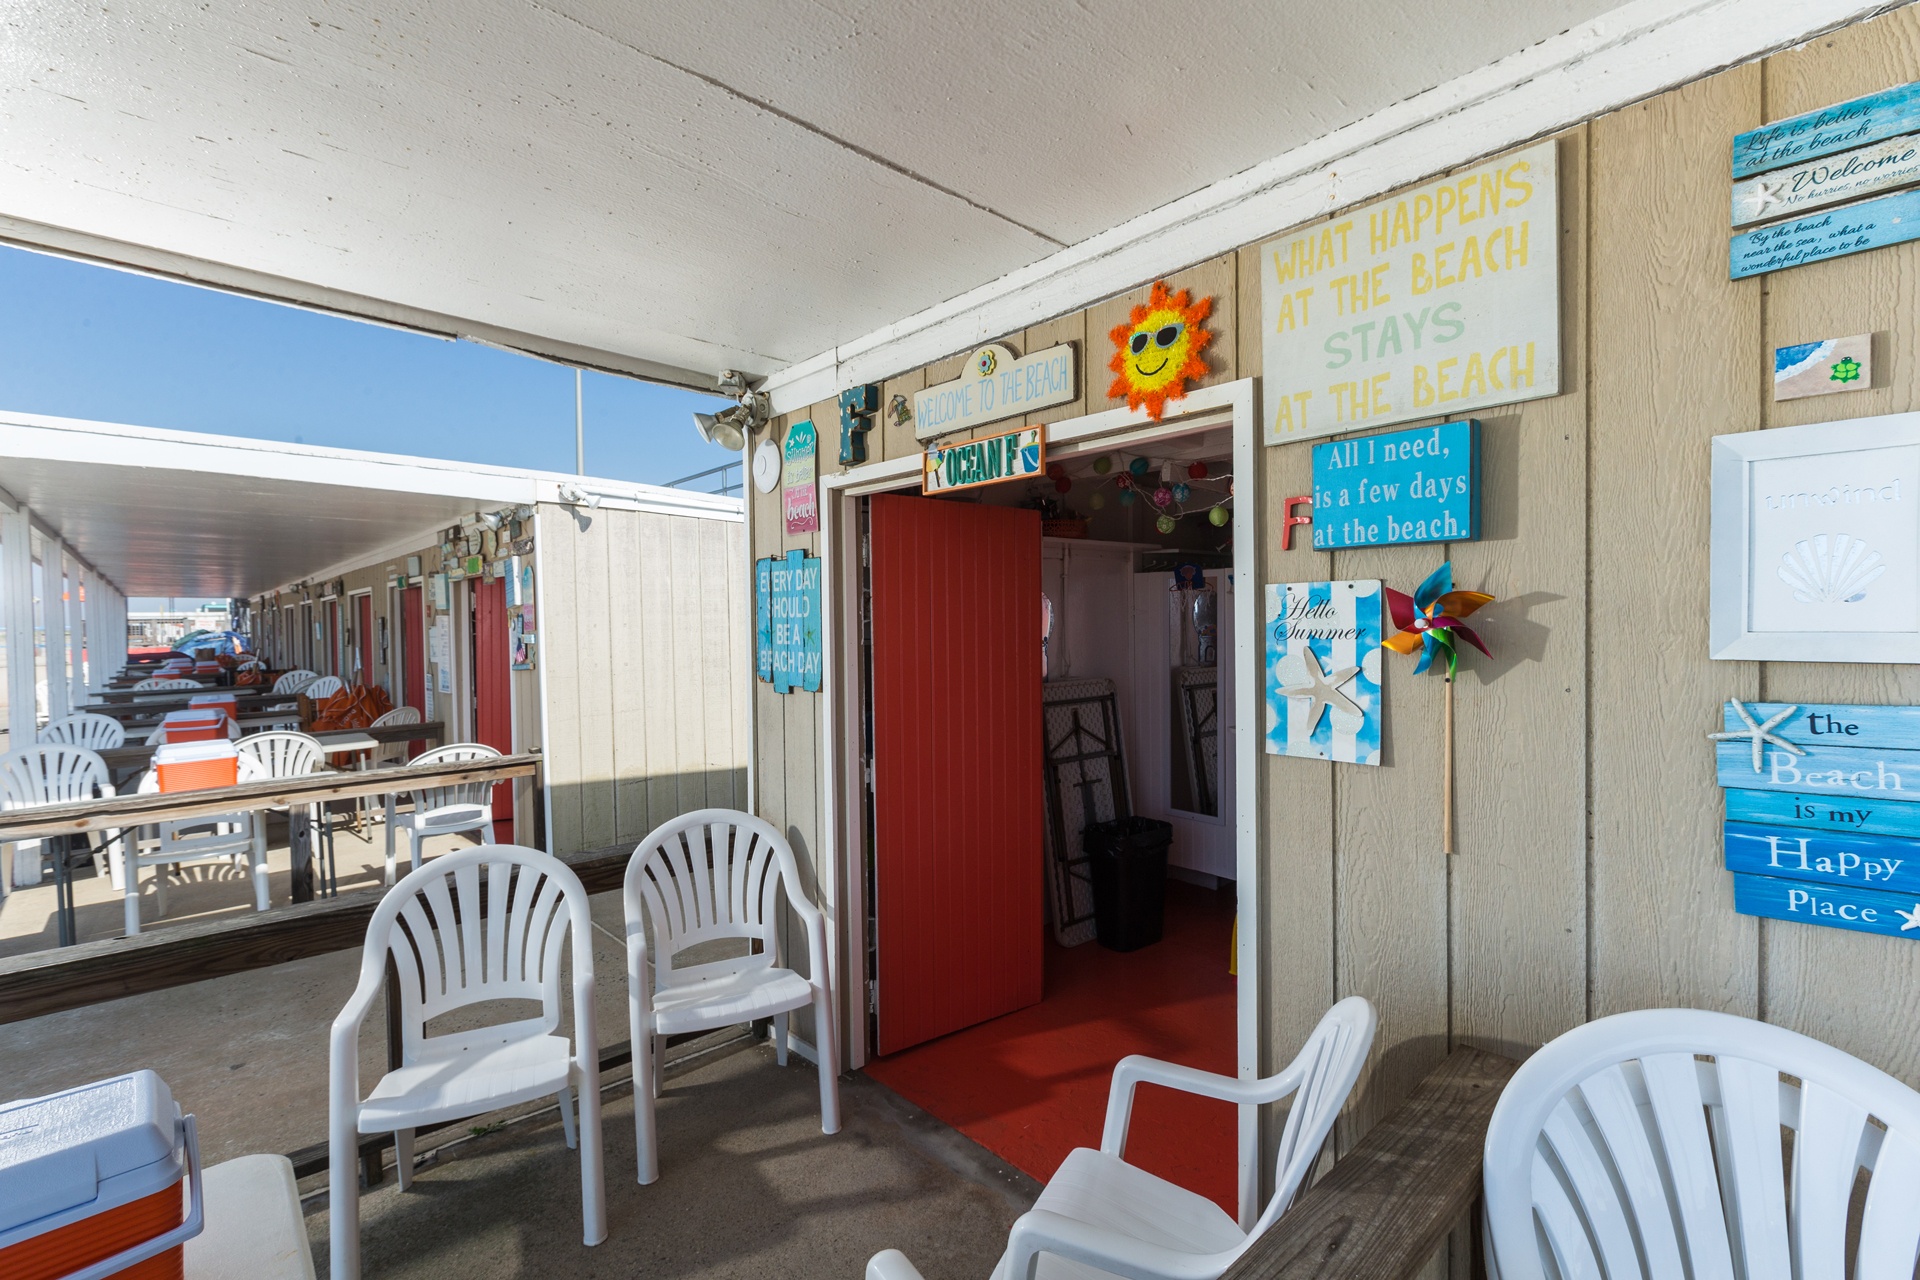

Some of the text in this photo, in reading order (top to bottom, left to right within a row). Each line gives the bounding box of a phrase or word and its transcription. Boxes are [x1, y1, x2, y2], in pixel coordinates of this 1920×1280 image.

[1745, 105, 1872, 153] Life is better
[1745, 119, 1872, 168] at the beach
[1791, 148, 1918, 193] Welcome
[1782, 193, 1806, 208] No
[1807, 183, 1852, 201] hurries,
[1855, 177, 1871, 189] no
[1273, 161, 1534, 285] WHAT HAPPENS
[1743, 221, 1877, 260] near the sea, what a
[1749, 215, 1833, 248] By the beach
[1740, 236, 1870, 274] wonderful place to be
[1276, 221, 1530, 333] AT THE BEACH
[1323, 301, 1465, 370] STAYS
[917, 354, 1068, 430] WELCOME TO THE BEACH
[1274, 341, 1536, 434] AT THE BEACH
[838, 383, 878, 466] F
[945, 434, 1019, 486] OCEAN F
[1327, 428, 1449, 470] All I need,
[787, 494, 815, 521] beach
[1315, 472, 1468, 509] is a few days
[1764, 478, 1902, 510] unwind
[1314, 510, 1467, 547] at the beach.
[760, 567, 818, 593] EVERY DAY
[766, 596, 811, 618] SHOULD
[1277, 593, 1338, 621] Hello
[776, 624, 800, 645] BE A
[1274, 619, 1367, 645] Summer
[760, 650, 820, 674] BEACH DAY
[1806, 712, 1860, 736] the
[1769, 752, 1904, 790] Beach
[1794, 796, 1873, 828] is my
[1765, 836, 1904, 881] Happy
